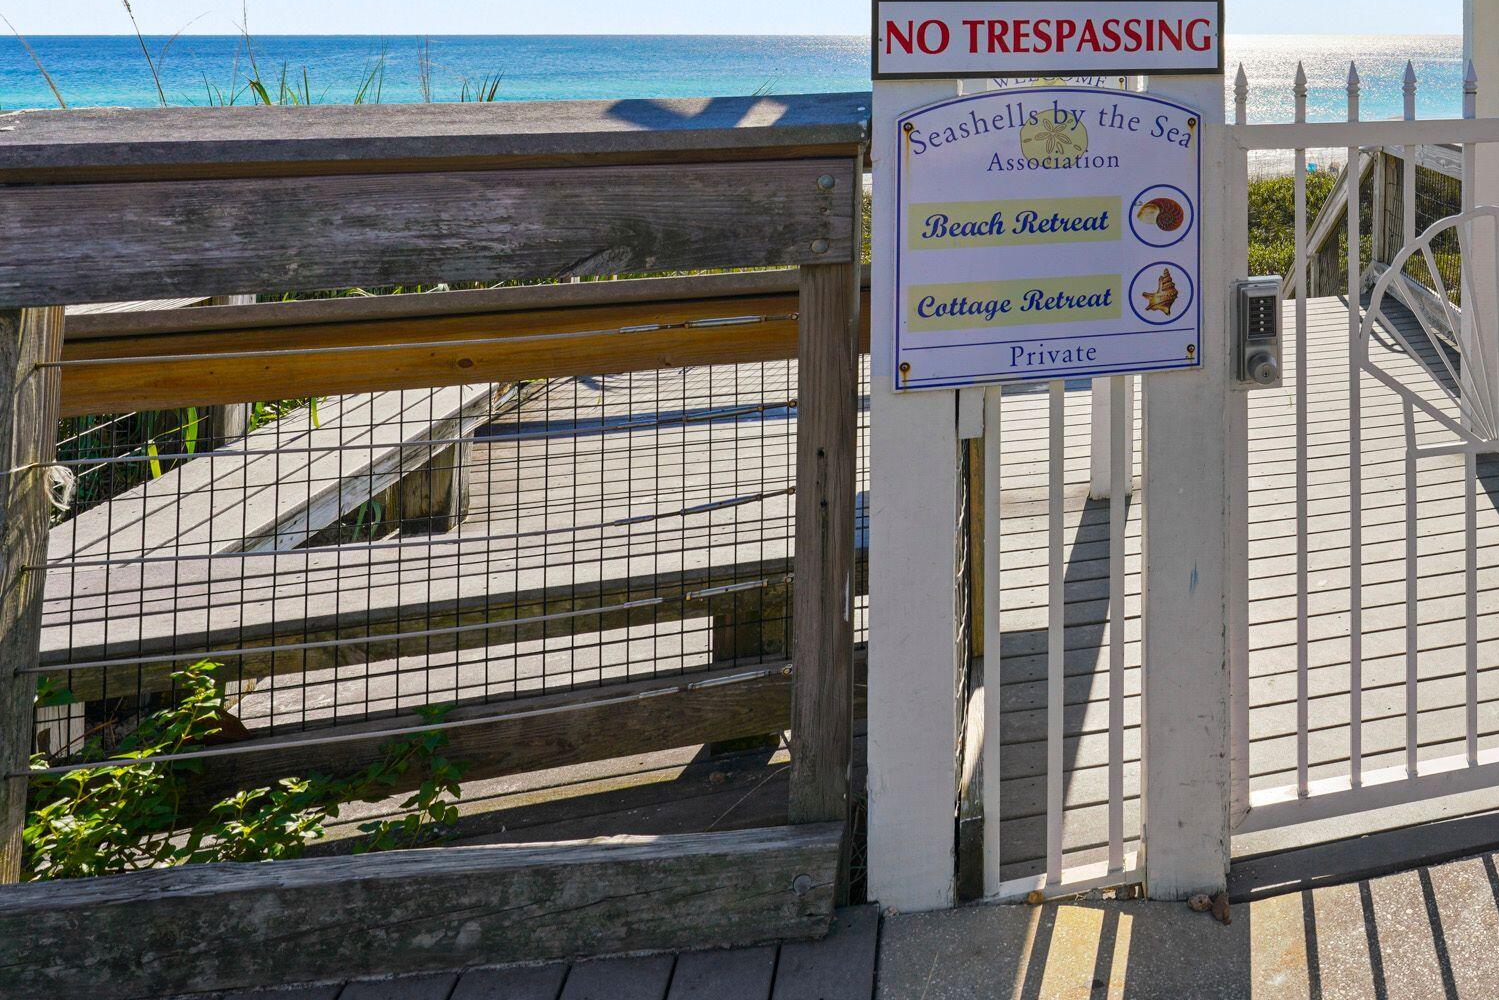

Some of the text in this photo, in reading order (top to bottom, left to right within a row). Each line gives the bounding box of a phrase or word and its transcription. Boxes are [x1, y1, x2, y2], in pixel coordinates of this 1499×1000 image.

[885, 18, 1212, 54] NO TRESPASSING
[908, 100, 1193, 155] Seashells by the Sea
[986, 149, 1120, 172] Association
[921, 205, 1110, 239] Beach Retreat
[917, 287, 1113, 322] Cottage Retreat
[1009, 343, 1097, 368] Private
